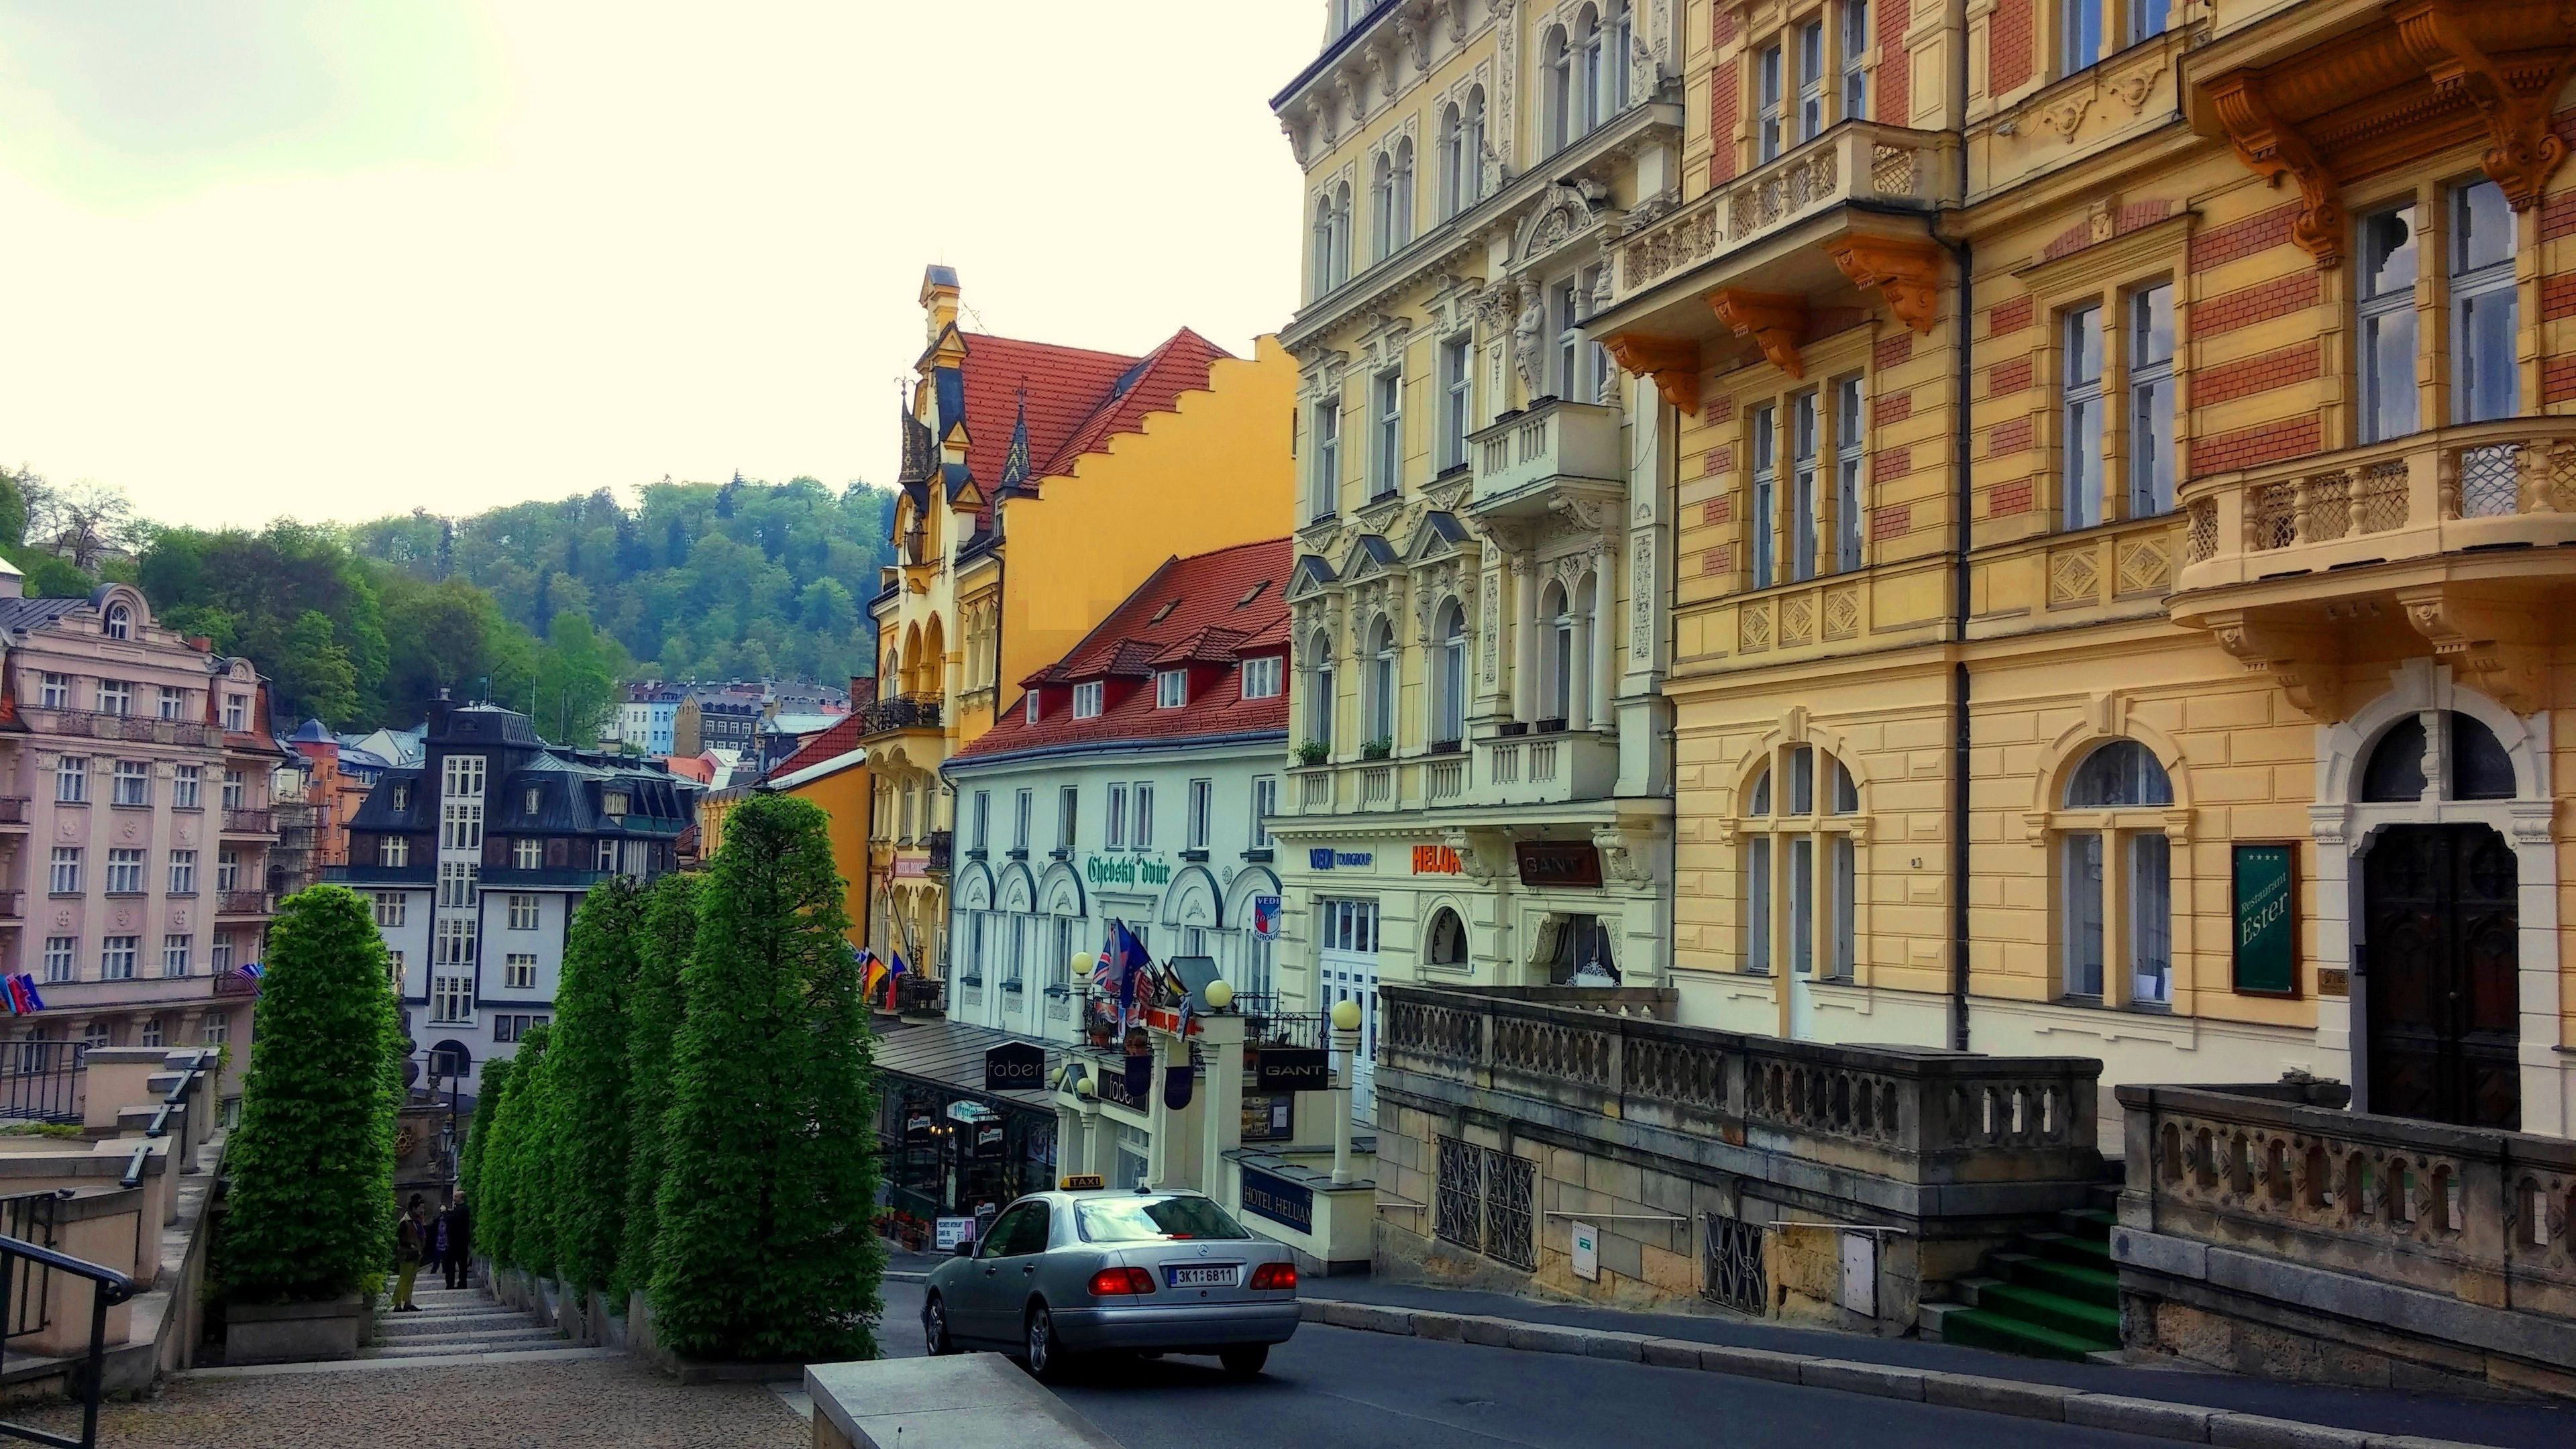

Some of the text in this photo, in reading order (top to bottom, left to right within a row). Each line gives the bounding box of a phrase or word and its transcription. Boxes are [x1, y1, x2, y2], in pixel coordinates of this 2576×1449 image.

[1309, 849, 1372, 869] VEDI TOURGROUP
[1412, 845, 1462, 875] HELUA
[1087, 856, 1171, 892] Chebský dvůr
[2241, 871, 2288, 915] Restaurant
[2242, 892, 2289, 947] Ester
[1254, 930, 1281, 941] GROUP
[988, 1060, 1042, 1077] faber
[1265, 1065, 1324, 1075] GANT
[1071, 1177, 1099, 1186] TAXI
[1244, 1185, 1312, 1225] HOTEL HELUAN
[1179, 1270, 1198, 1283] 3K1
[1206, 1269, 1232, 1281] 6811
